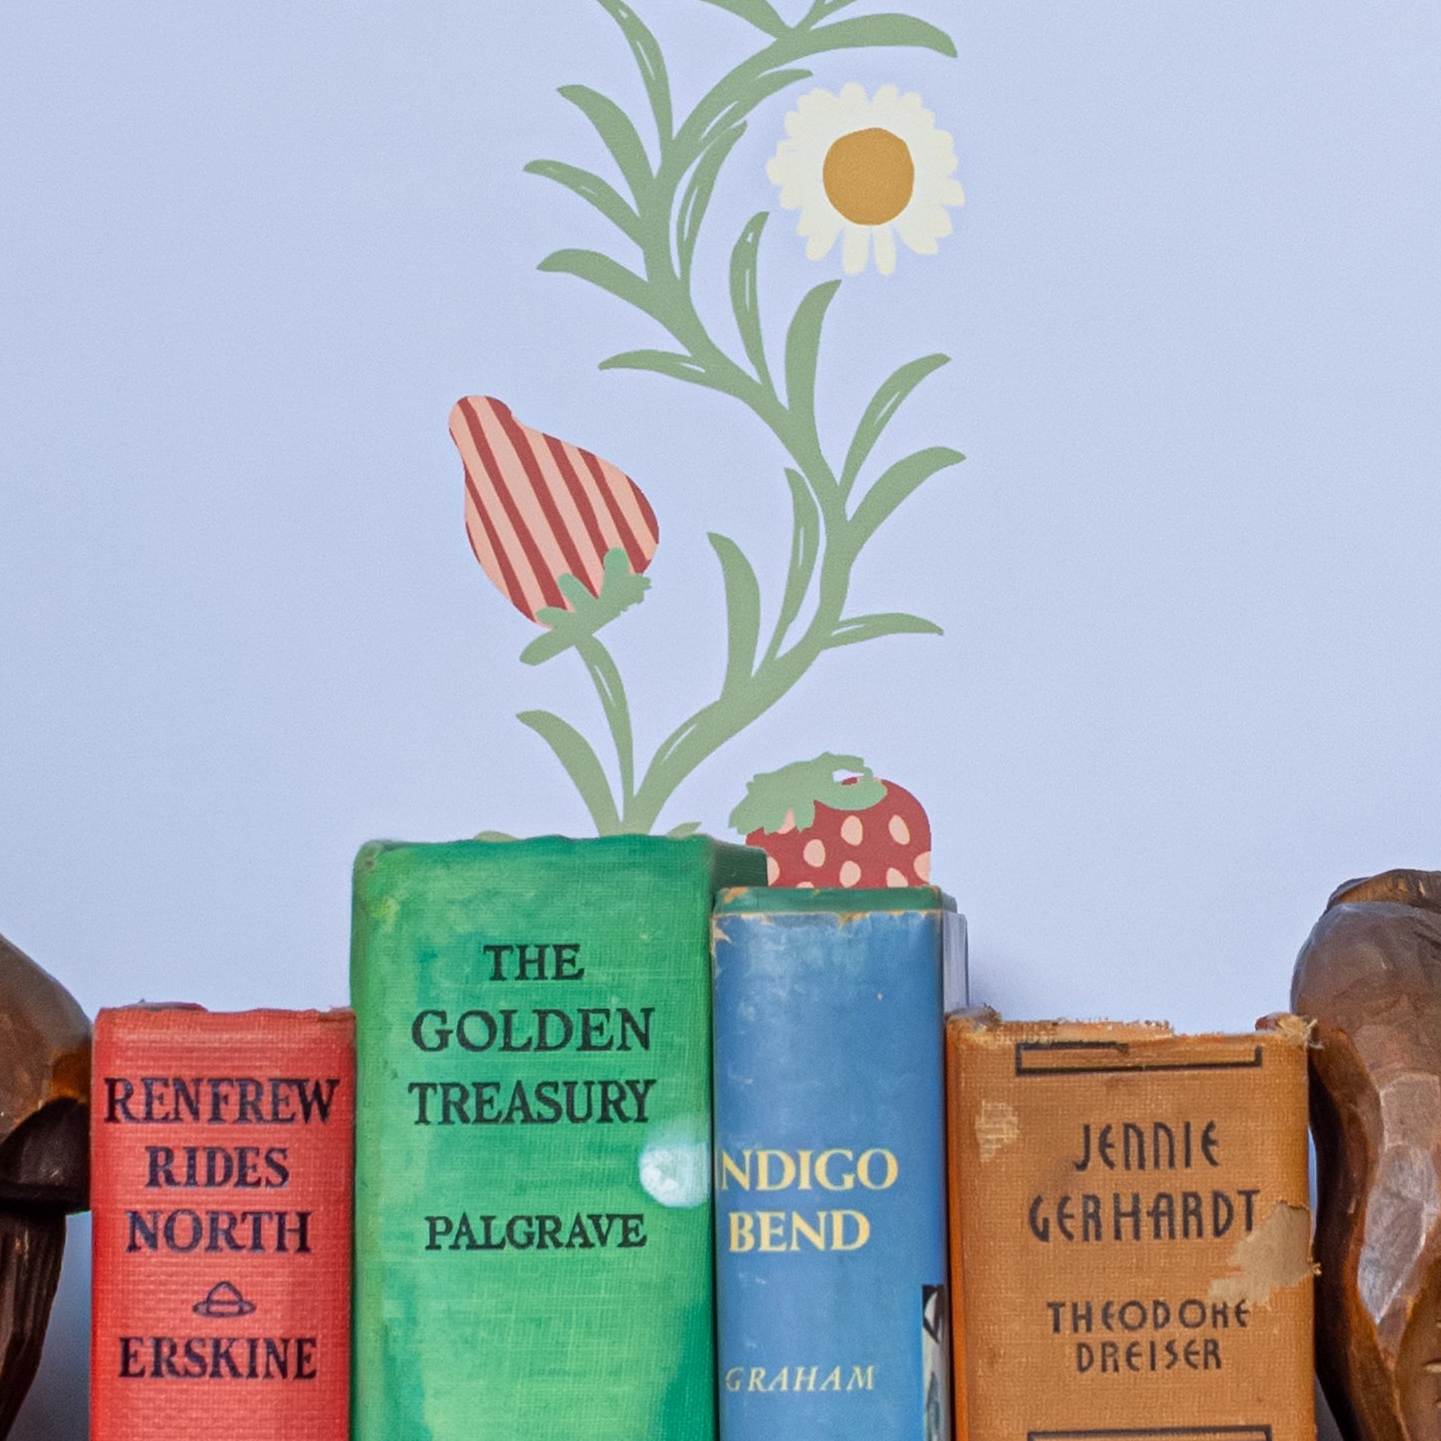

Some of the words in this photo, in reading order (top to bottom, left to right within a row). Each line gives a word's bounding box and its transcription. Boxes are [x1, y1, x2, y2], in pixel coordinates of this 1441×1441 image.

[483, 943, 585, 981] THE
[411, 1007, 655, 1052] GOLDEN
[104, 1077, 340, 1124] RENFREW
[408, 1079, 657, 1125] TREASURY
[1074, 1120, 1221, 1171] JENNIE
[145, 1146, 290, 1189] RIDES
[716, 1148, 899, 1191] NDIGO
[125, 1210, 312, 1253] NORTH
[425, 1212, 647, 1250] PALGRAVE
[728, 1210, 871, 1252] BEND
[1029, 1189, 1260, 1242] GERHARDT
[119, 1337, 317, 1380] ERSKINE
[1076, 1338, 1222, 1373] DREISER
[725, 1364, 876, 1392] GRAHAM
